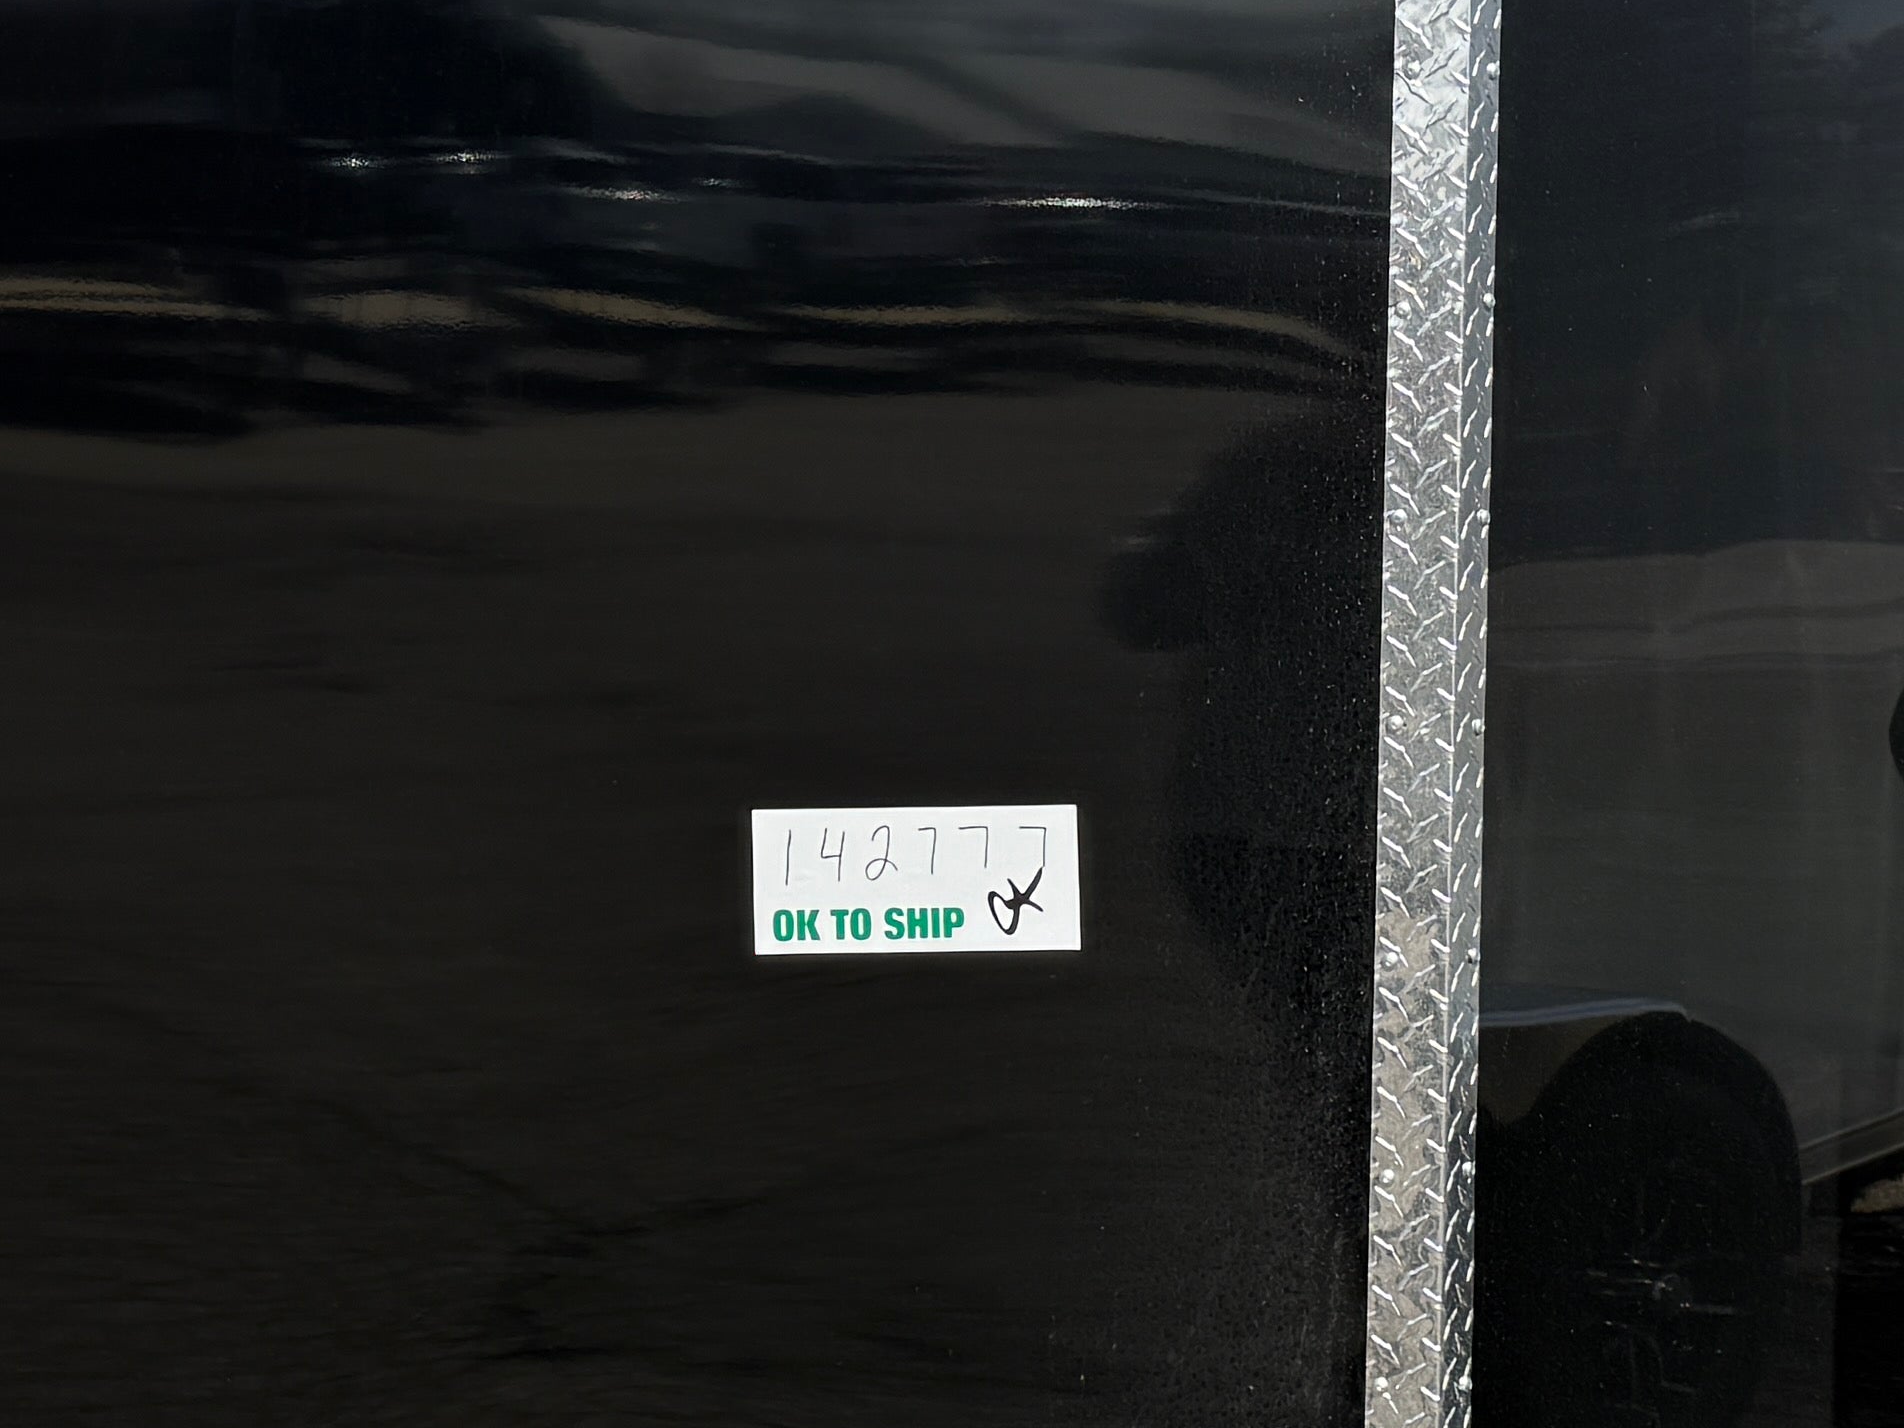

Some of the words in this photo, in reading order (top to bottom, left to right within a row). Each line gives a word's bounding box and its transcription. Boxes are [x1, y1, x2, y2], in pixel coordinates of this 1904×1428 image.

[784, 824, 1047, 886] 142777
[772, 909, 821, 942] OK
[830, 908, 872, 941] TO
[883, 907, 965, 940] SHIP
